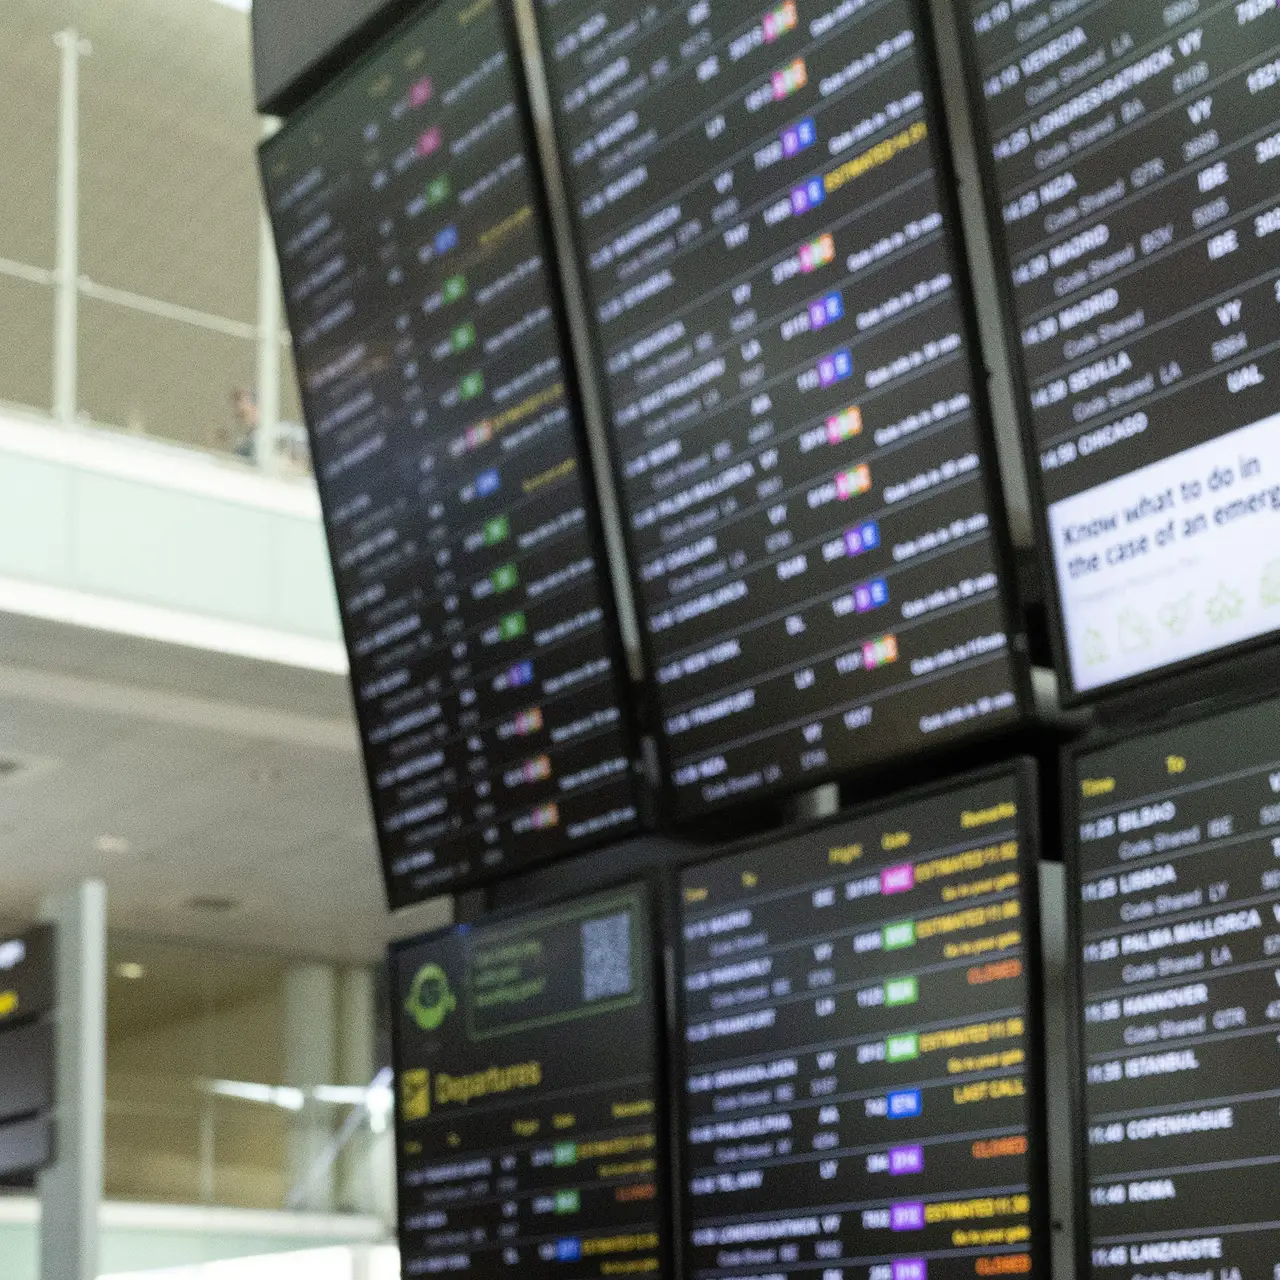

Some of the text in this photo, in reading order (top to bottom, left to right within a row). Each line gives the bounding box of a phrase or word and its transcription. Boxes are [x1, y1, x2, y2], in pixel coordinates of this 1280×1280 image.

[1123, 488, 1175, 523] what
[1180, 480, 1202, 503] to
[1207, 465, 1235, 492] do
[1239, 456, 1262, 479] in
[1068, 553, 1100, 580] the
[1105, 536, 1149, 565] case
[1154, 520, 1175, 547] of
[1182, 513, 1208, 538] an
